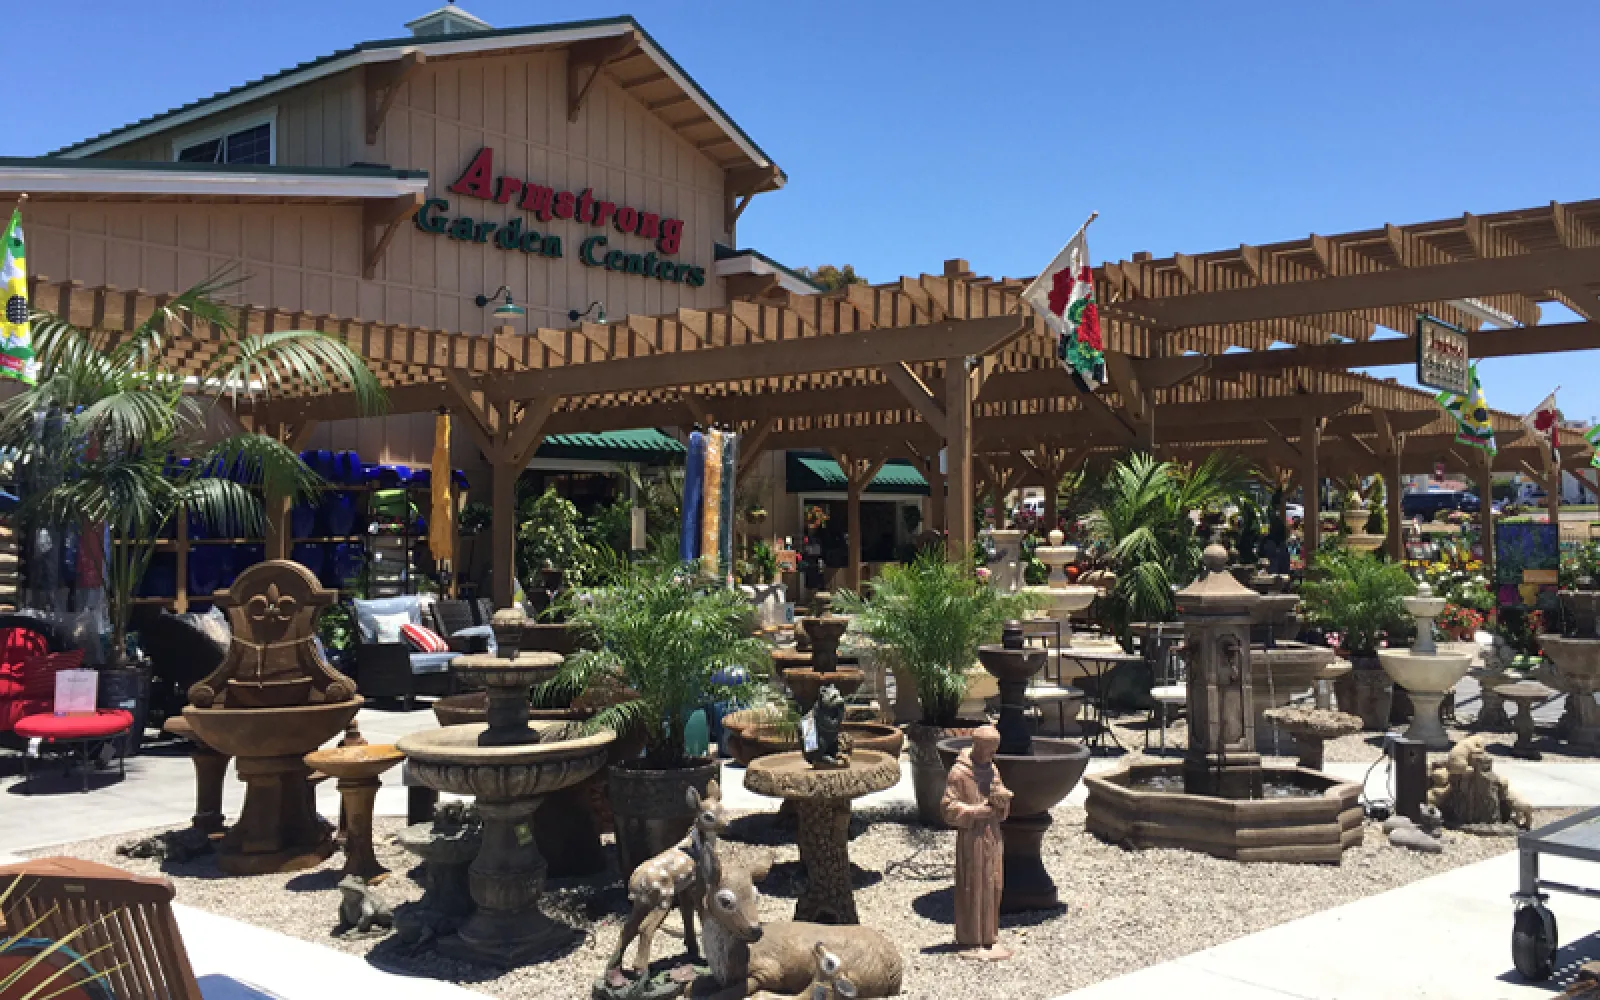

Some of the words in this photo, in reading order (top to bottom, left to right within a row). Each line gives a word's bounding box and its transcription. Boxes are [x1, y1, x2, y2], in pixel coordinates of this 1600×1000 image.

[415, 198, 562, 258] Garden
[580, 235, 705, 287] Centers
[449, 147, 684, 254] Armstrong
